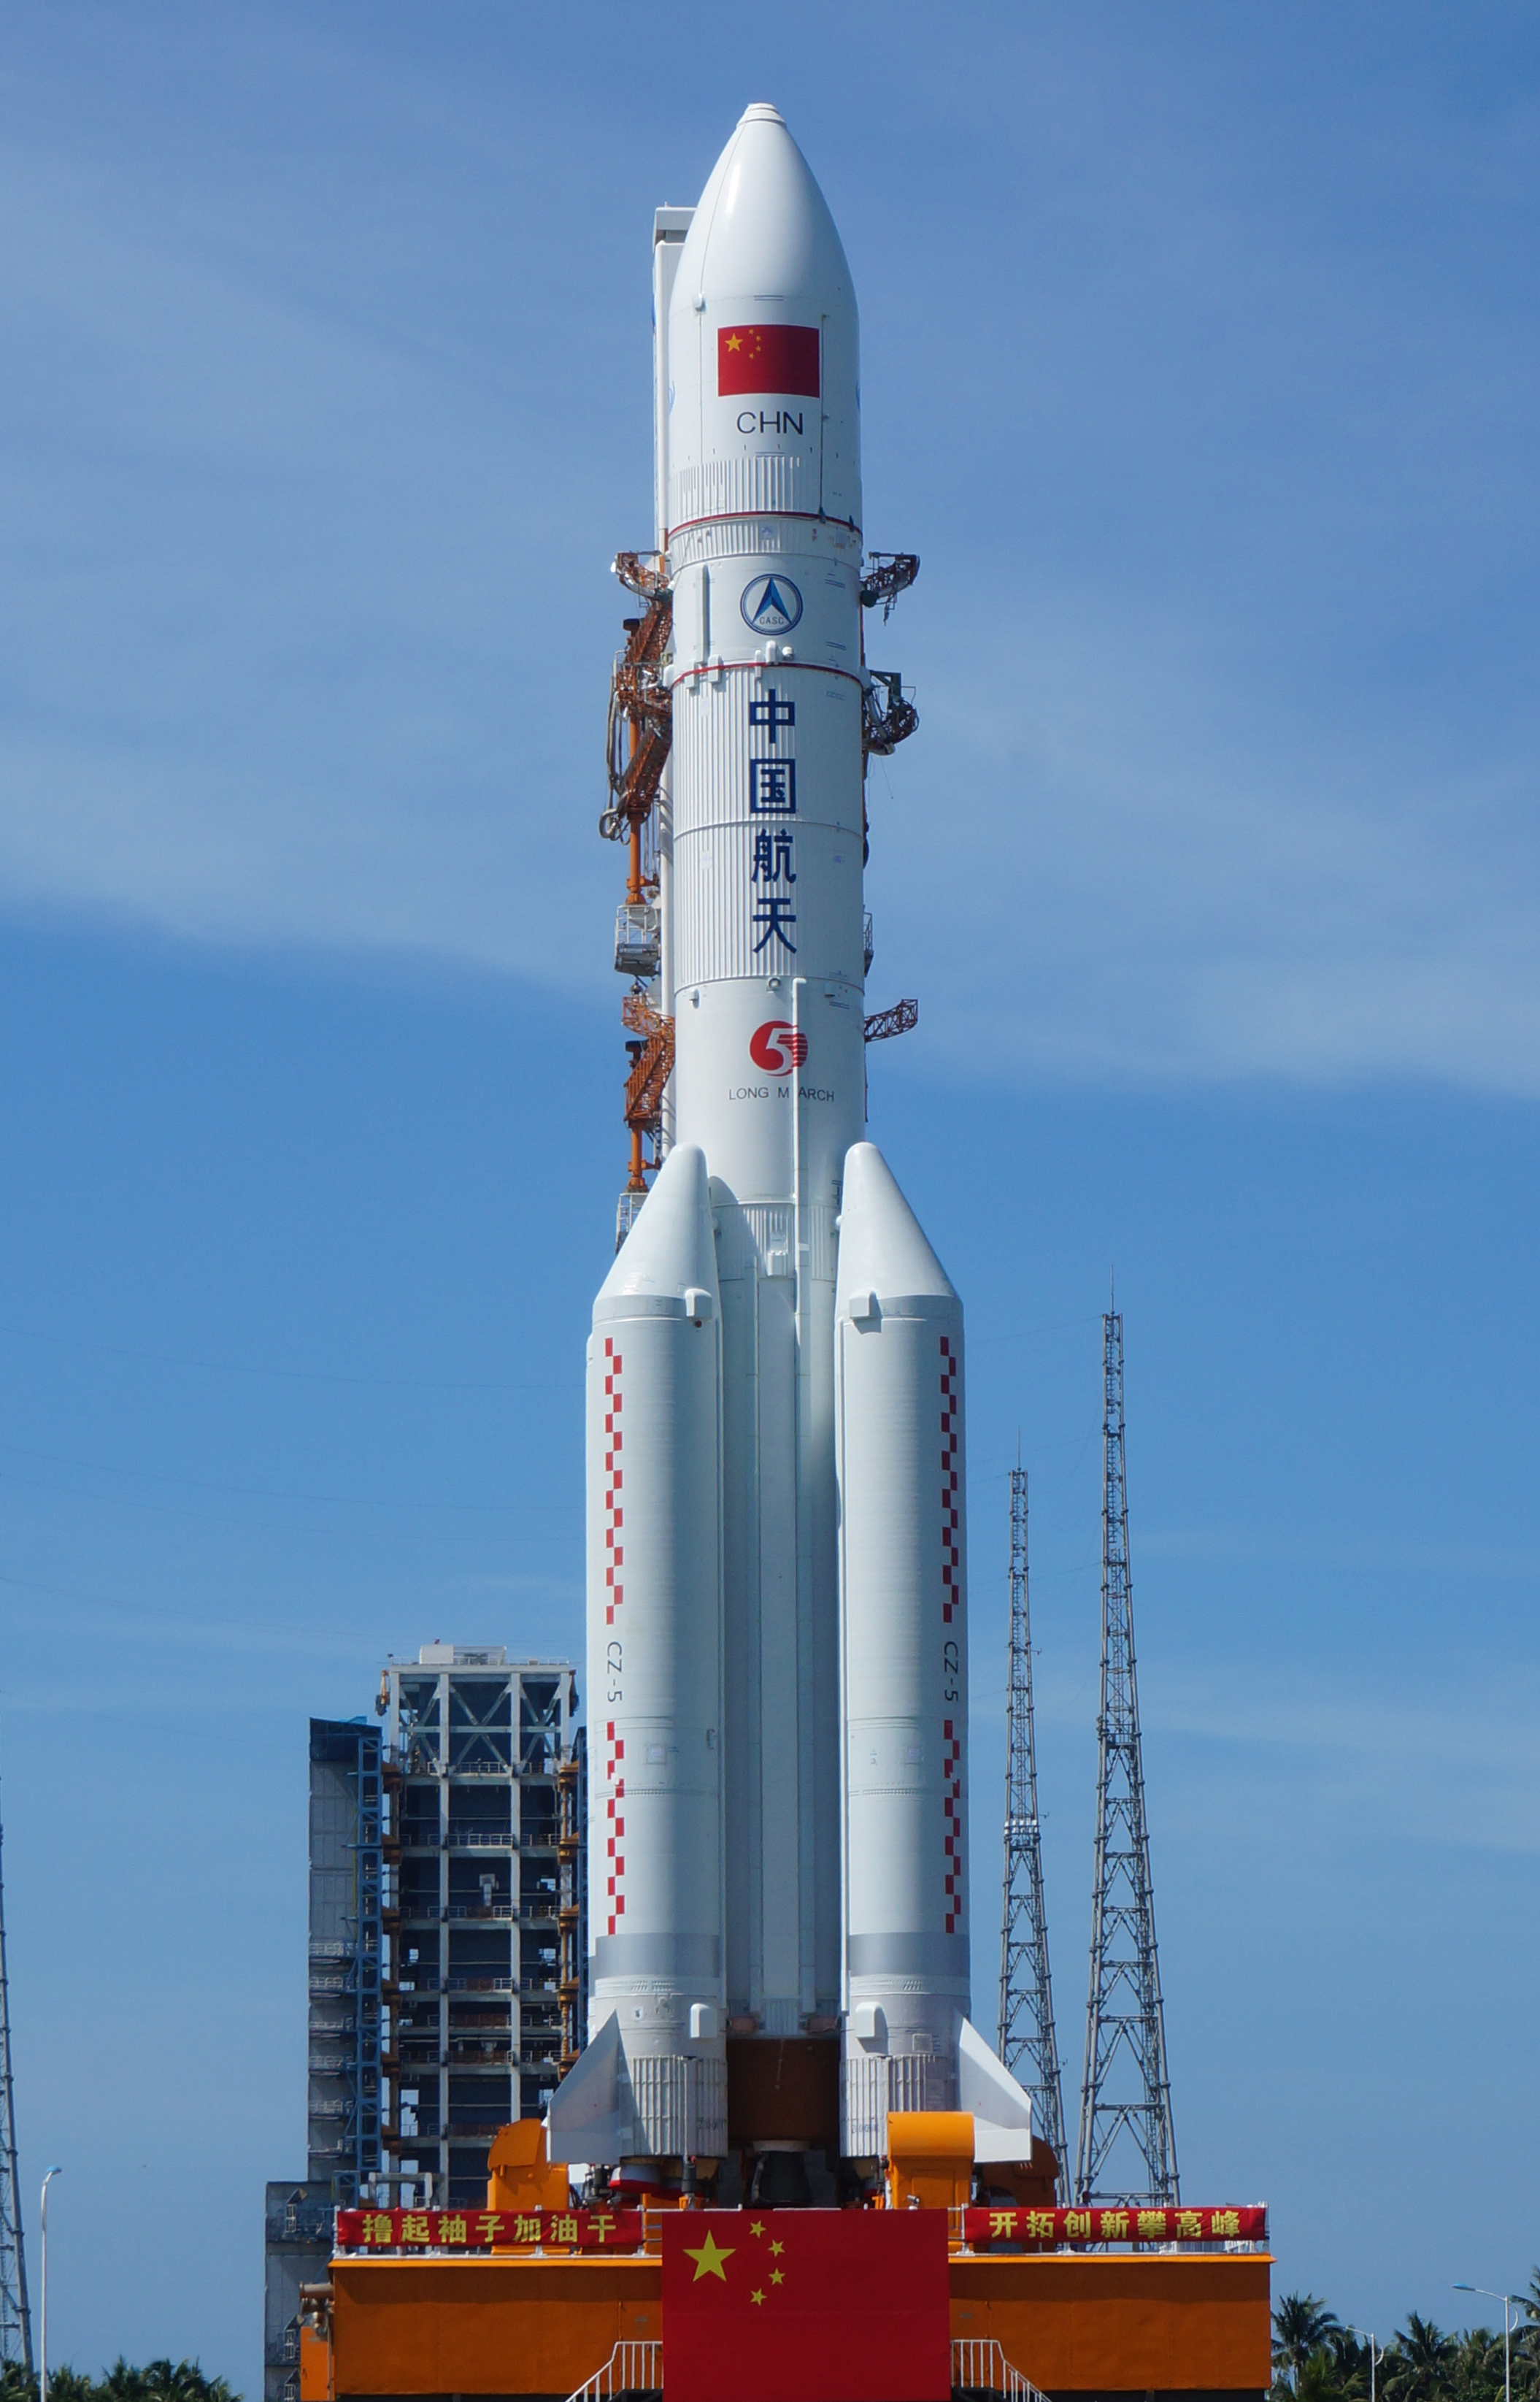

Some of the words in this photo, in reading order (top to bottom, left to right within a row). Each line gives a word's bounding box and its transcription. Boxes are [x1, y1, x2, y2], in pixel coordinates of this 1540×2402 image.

[736, 410, 804, 436] CHN
[758, 615, 785, 625] CASC
[749, 688, 797, 955] 中国航天
[728, 1086, 769, 1100] LONG
[607, 1641, 623, 1703] CZ-5
[944, 1641, 959, 1702] CZ-5
[362, 2214, 616, 2243] 撸起袖子加油干
[989, 2210, 1240, 2238] 开拓创新攀高峰
